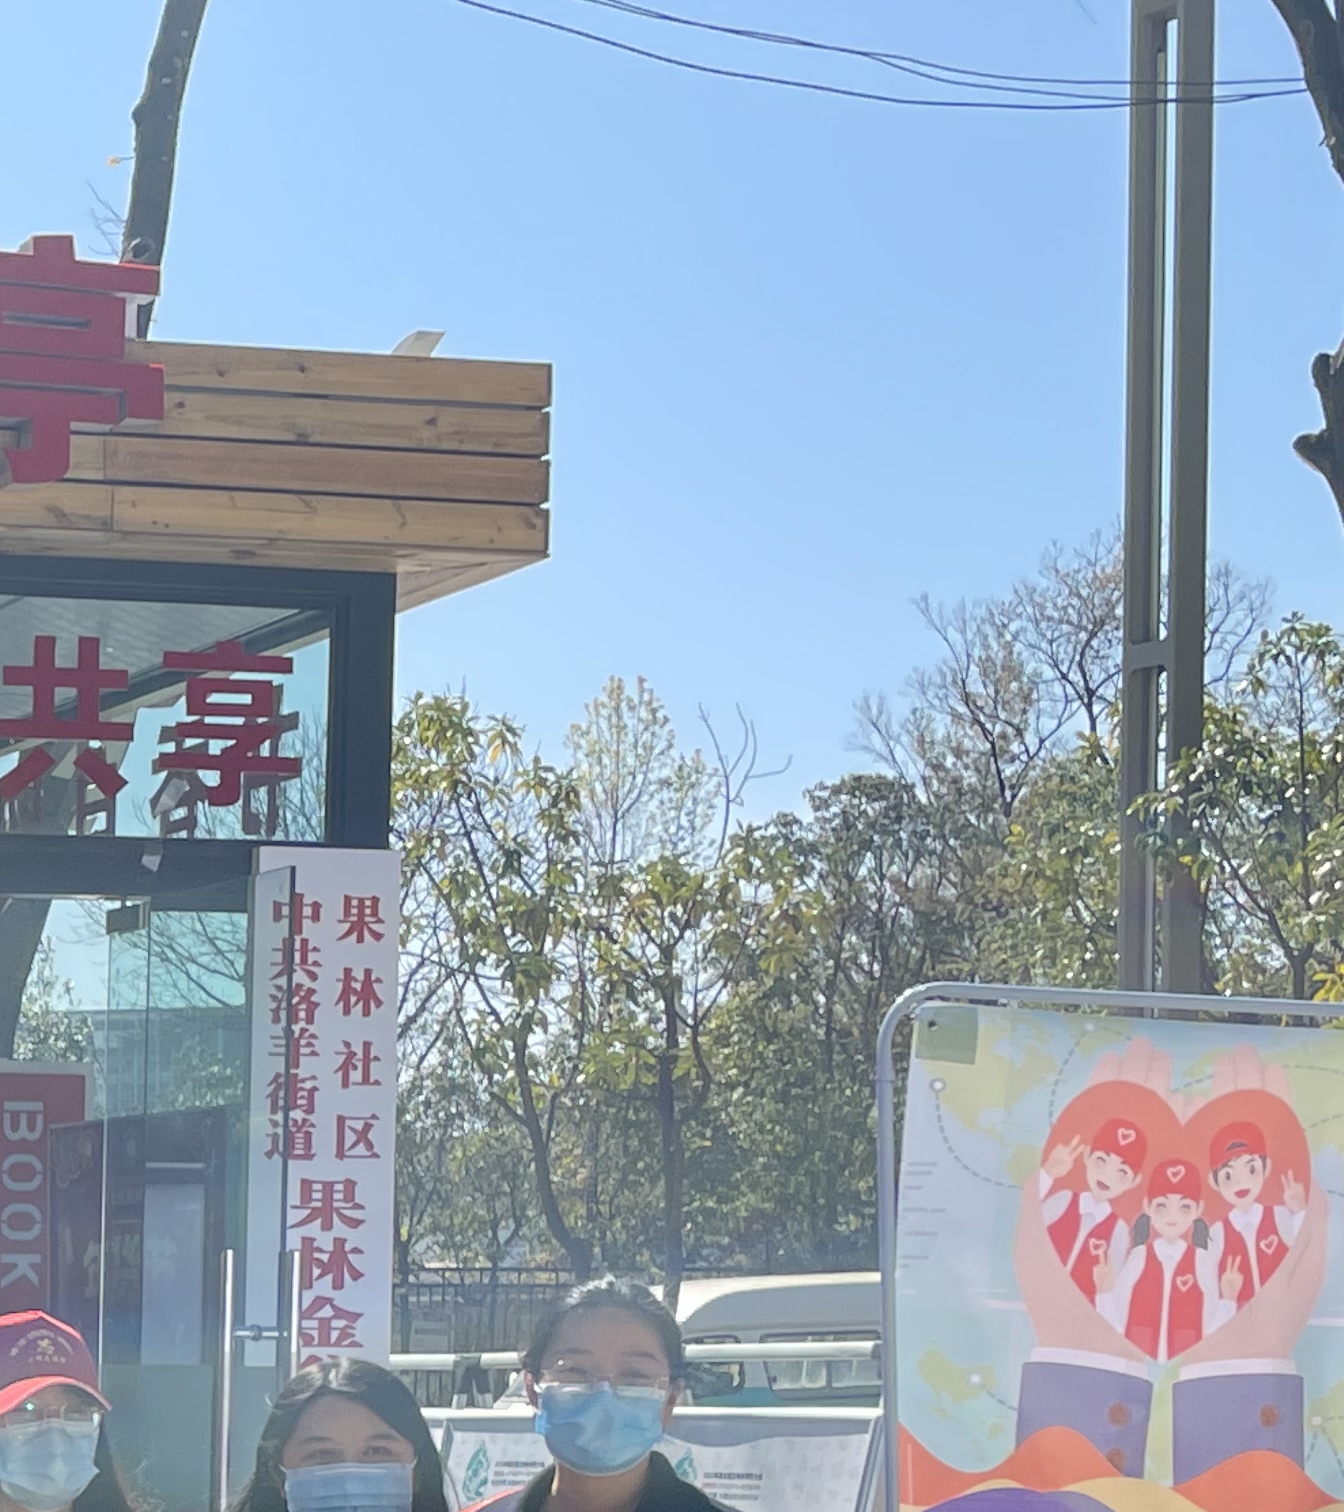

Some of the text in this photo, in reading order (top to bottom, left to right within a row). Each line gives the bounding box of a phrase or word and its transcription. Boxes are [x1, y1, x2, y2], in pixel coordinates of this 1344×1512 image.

[263, 892, 323, 1161] 中共洛羊街道
[333, 894, 386, 1161] 果林社区
[0, 1101, 44, 1288] BOOK
[287, 1177, 366, 1370] 果林金
